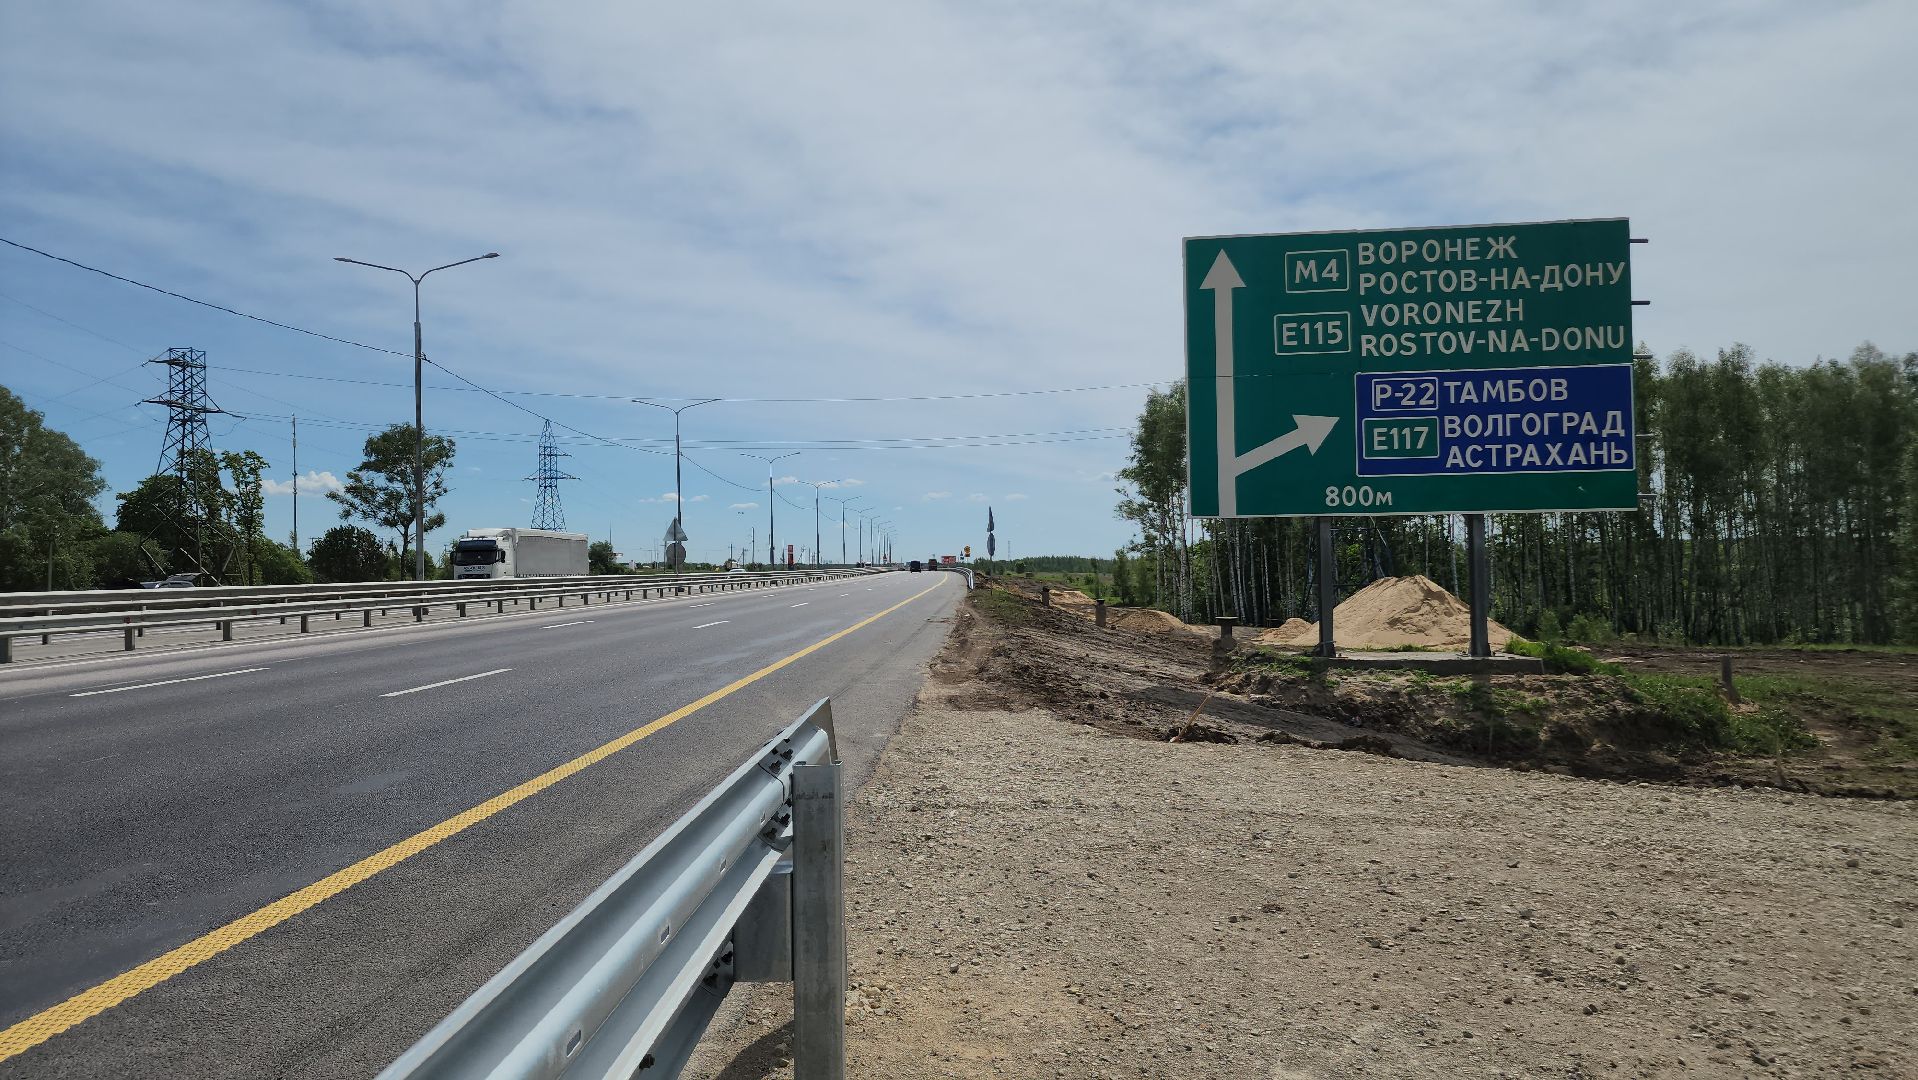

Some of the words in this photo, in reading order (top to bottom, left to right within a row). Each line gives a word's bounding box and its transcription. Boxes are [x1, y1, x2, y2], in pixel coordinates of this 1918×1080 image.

[1358, 236, 1518, 265] ВОРОНЕЖ
[1296, 258, 1339, 284] М4
[1359, 261, 1625, 296] РОСТОВ-НА-ДОНУ
[1361, 299, 1523, 327] VORONEZH
[1282, 320, 1343, 346] E115
[1361, 325, 1625, 357] ROSTOV-NA-DONU
[1375, 382, 1435, 407] Р-22
[1443, 378, 1568, 404] ТАМБОВ
[1444, 410, 1625, 439] ВОЛГОГРАД
[1373, 426, 1429, 451] E117
[1445, 441, 1628, 468] АСТРАХАНЬ
